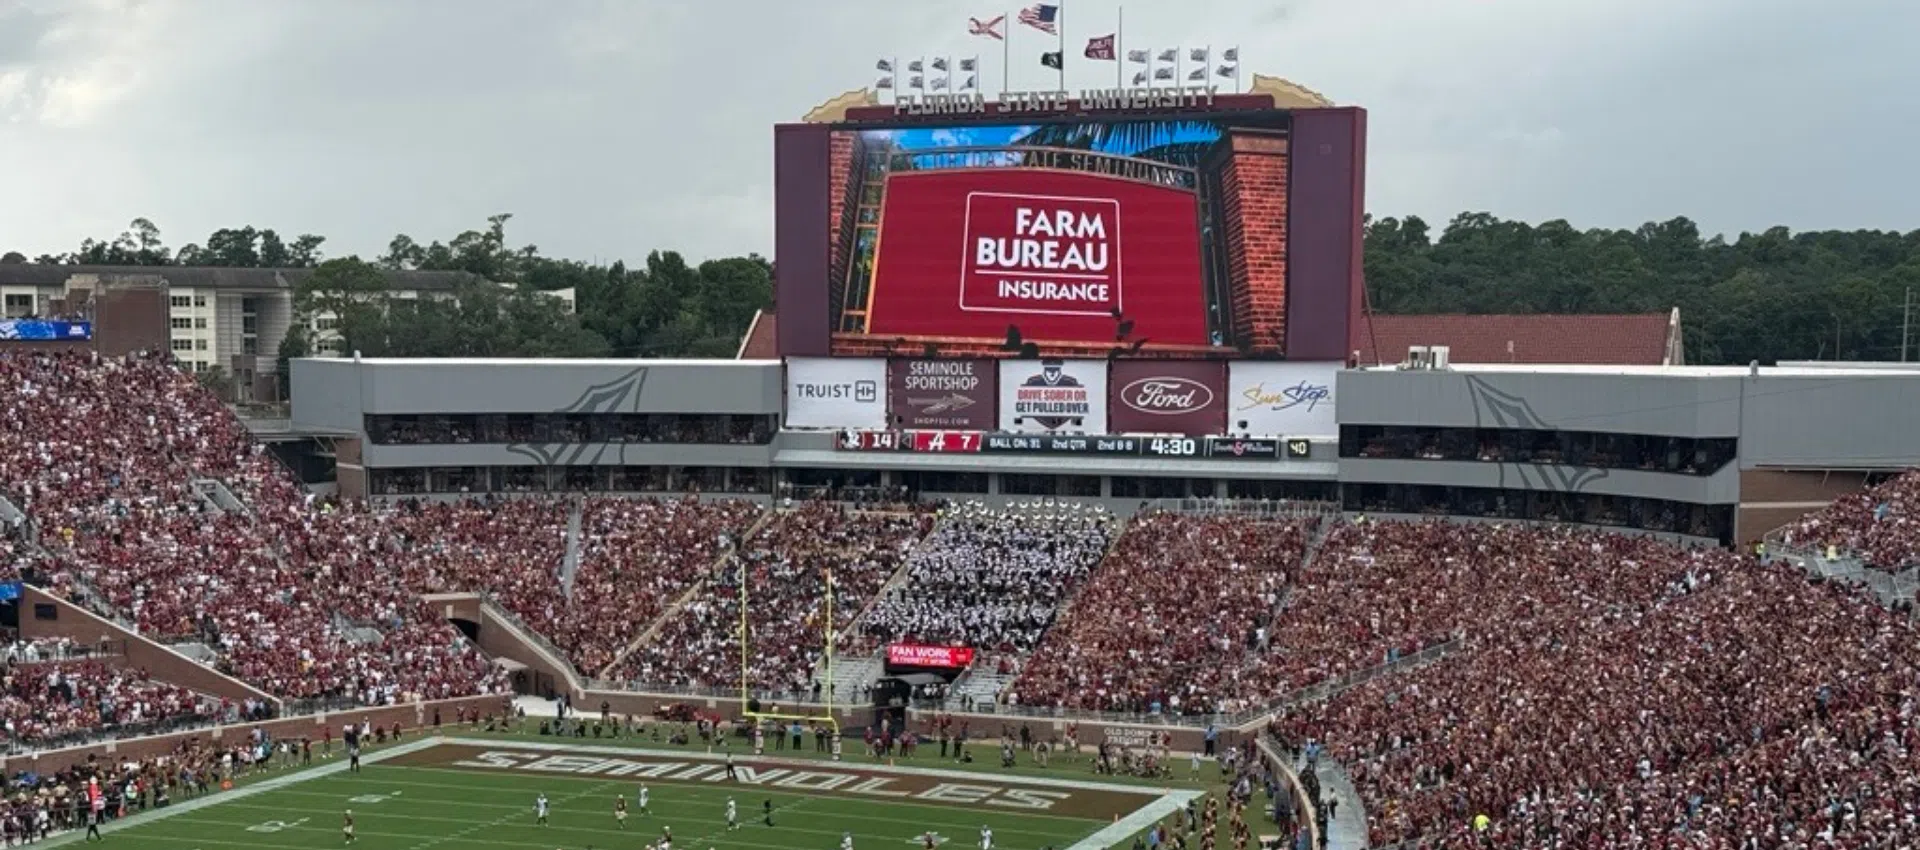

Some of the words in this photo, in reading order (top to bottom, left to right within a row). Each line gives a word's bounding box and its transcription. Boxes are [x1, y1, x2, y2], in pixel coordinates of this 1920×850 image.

[895, 95, 985, 115] FLORIDA
[997, 91, 1069, 112] STATE
[1079, 86, 1218, 109] UNIVERSITY
[1015, 207, 1106, 239] FARM
[976, 237, 1108, 271] BUREAU
[998, 280, 1109, 302] INSURANCE
[909, 361, 973, 376] SEMINOLE
[905, 376, 979, 390] SPORTSHOP
[796, 384, 852, 398] TRUIST
[1018, 390, 1042, 400] DRIVE
[1044, 390, 1073, 401] SOBER
[1074, 390, 1087, 401] OR
[1136, 382, 1196, 408] Ford
[1016, 402, 1031, 413] GET
[1033, 402, 1065, 413] PULLED
[1066, 402, 1089, 413] OVER
[872, 434, 892, 448] 14
[961, 435, 972, 449] 7
[989, 438, 1011, 448] BALL
[1052, 440, 1067, 449] 2nd
[1070, 440, 1087, 450] QTR
[1097, 440, 1115, 450] 2nd
[1151, 439, 1195, 455] 4:30
[1290, 442, 1307, 454] 40
[892, 646, 914, 656] FAN
[917, 646, 950, 657] WORK
[1104, 727, 1122, 736] OLD
[452, 751, 1072, 810] SEMINOLES
